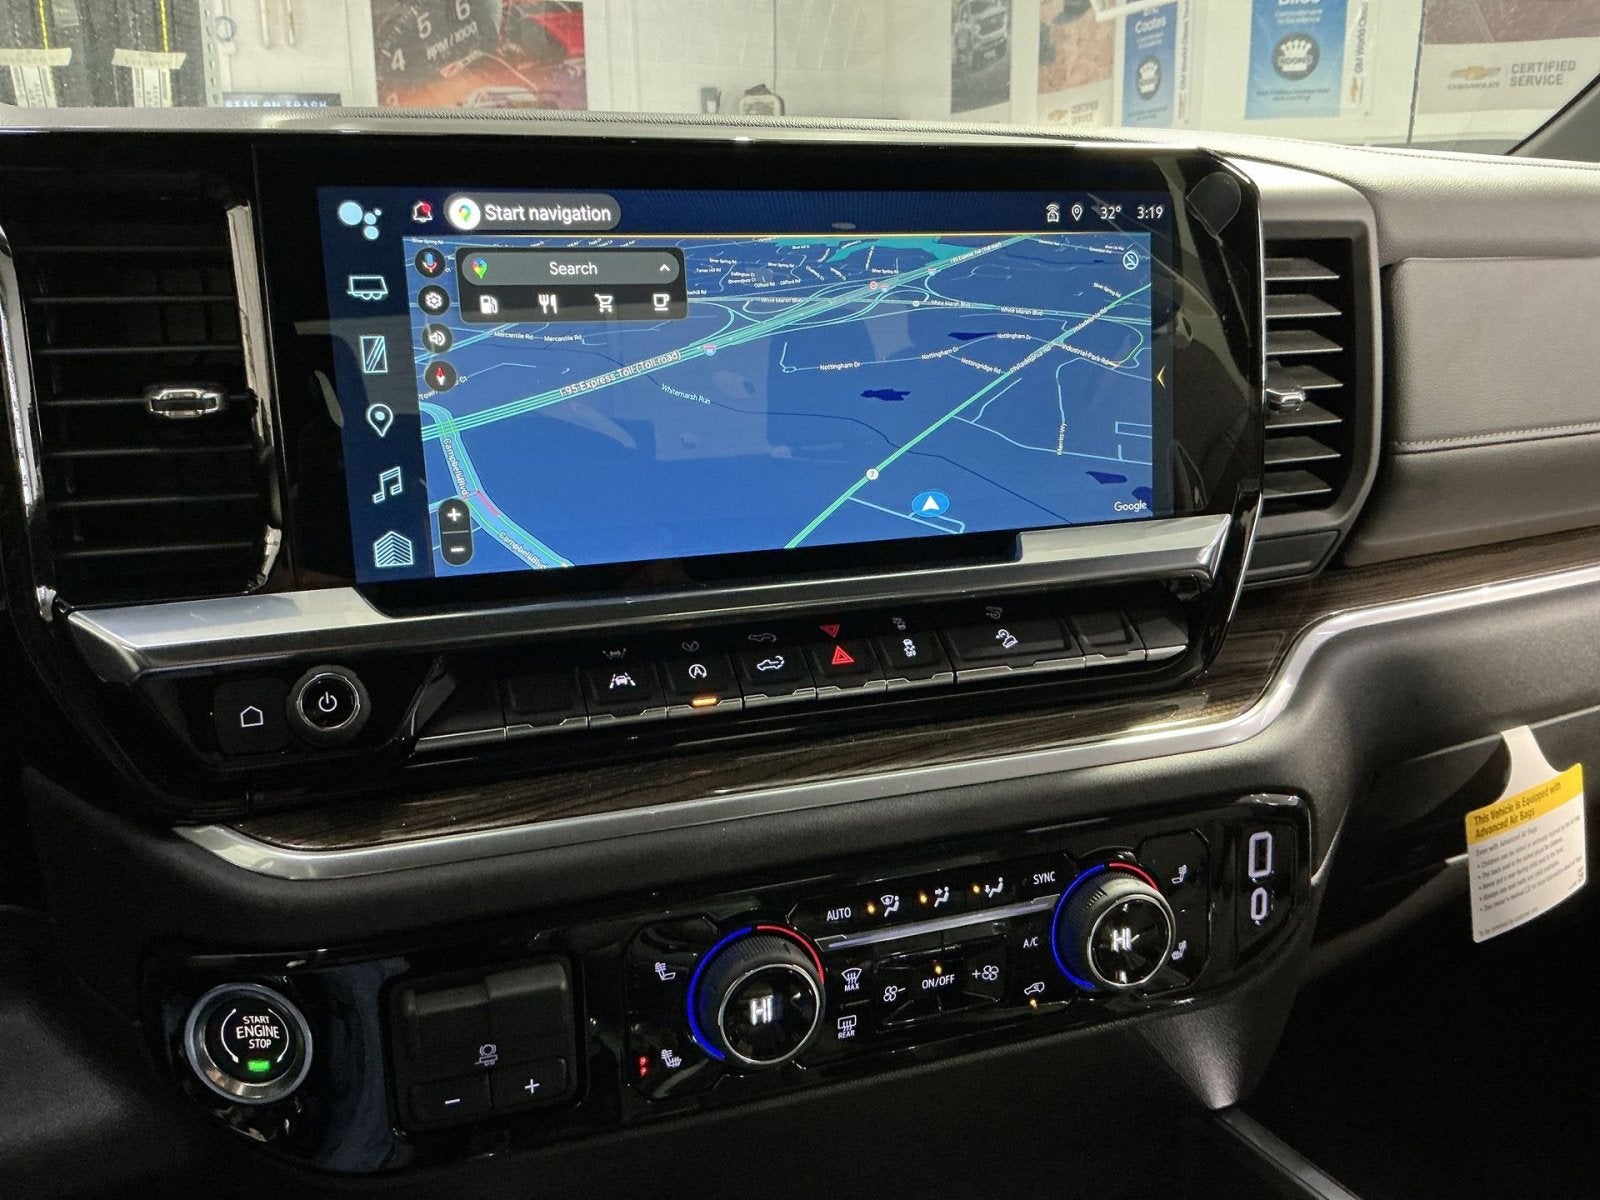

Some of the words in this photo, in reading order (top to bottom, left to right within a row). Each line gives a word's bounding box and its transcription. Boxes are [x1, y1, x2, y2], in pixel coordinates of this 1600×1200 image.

[455, 0, 470, 21] 6
[417, 11, 431, 39] 5
[391, 48, 405, 71] 4
[1511, 60, 1577, 75] CERTIFIED
[1509, 73, 1564, 87] SERVICE
[484, 204, 525, 221] Start
[528, 204, 611, 225] navigation
[1100, 205, 1121, 220] 32°
[1136, 205, 1163, 220] 3:19
[549, 261, 599, 276] Search
[1016, 307, 1032, 315] Marsh
[494, 331, 525, 340] Mercantile
[525, 333, 534, 341] Rd
[921, 348, 951, 360] Nottingham
[952, 346, 960, 354] Dr
[1009, 350, 1042, 374] Philadelphia
[1041, 344, 1051, 356] Rd
[1062, 343, 1087, 358] Industrial
[1087, 353, 1100, 363] Park
[1100, 356, 1109, 365] Rd
[579, 374, 616, 391] Express
[617, 366, 636, 379] Toll
[635, 361, 656, 374] (Toll
[657, 349, 682, 366] road)
[819, 362, 853, 371] Nottingham
[993, 366, 1002, 375] Rd
[661, 383, 698, 401] Whitemarsh
[698, 395, 711, 405] Run
[1056, 434, 1065, 456] Merritt
[443, 438, 463, 480] Campbell
[457, 476, 470, 496] Blvd
[1114, 499, 1147, 512] Google
[498, 531, 533, 562] Campbell
[1474, 813, 1490, 827] This
[1490, 803, 1514, 820] Vehicle
[1515, 800, 1521, 810] is
[1522, 786, 1549, 807] Equipped
[1549, 782, 1561, 794] with
[1475, 818, 1508, 839] Advanced
[1509, 813, 1519, 826] Air
[1519, 808, 1535, 822] Bags
[1033, 871, 1056, 885] SYNC
[826, 906, 852, 921] AUTO
[1022, 935, 1039, 949] A/C
[844, 982, 860, 992] MAX
[921, 973, 955, 990] ON/OFF
[751, 994, 774, 1026] HI
[242, 1015, 271, 1025] START
[235, 1024, 281, 1040] ENGINE
[837, 1029, 856, 1040] REAR
[248, 1038, 272, 1050] STOP
